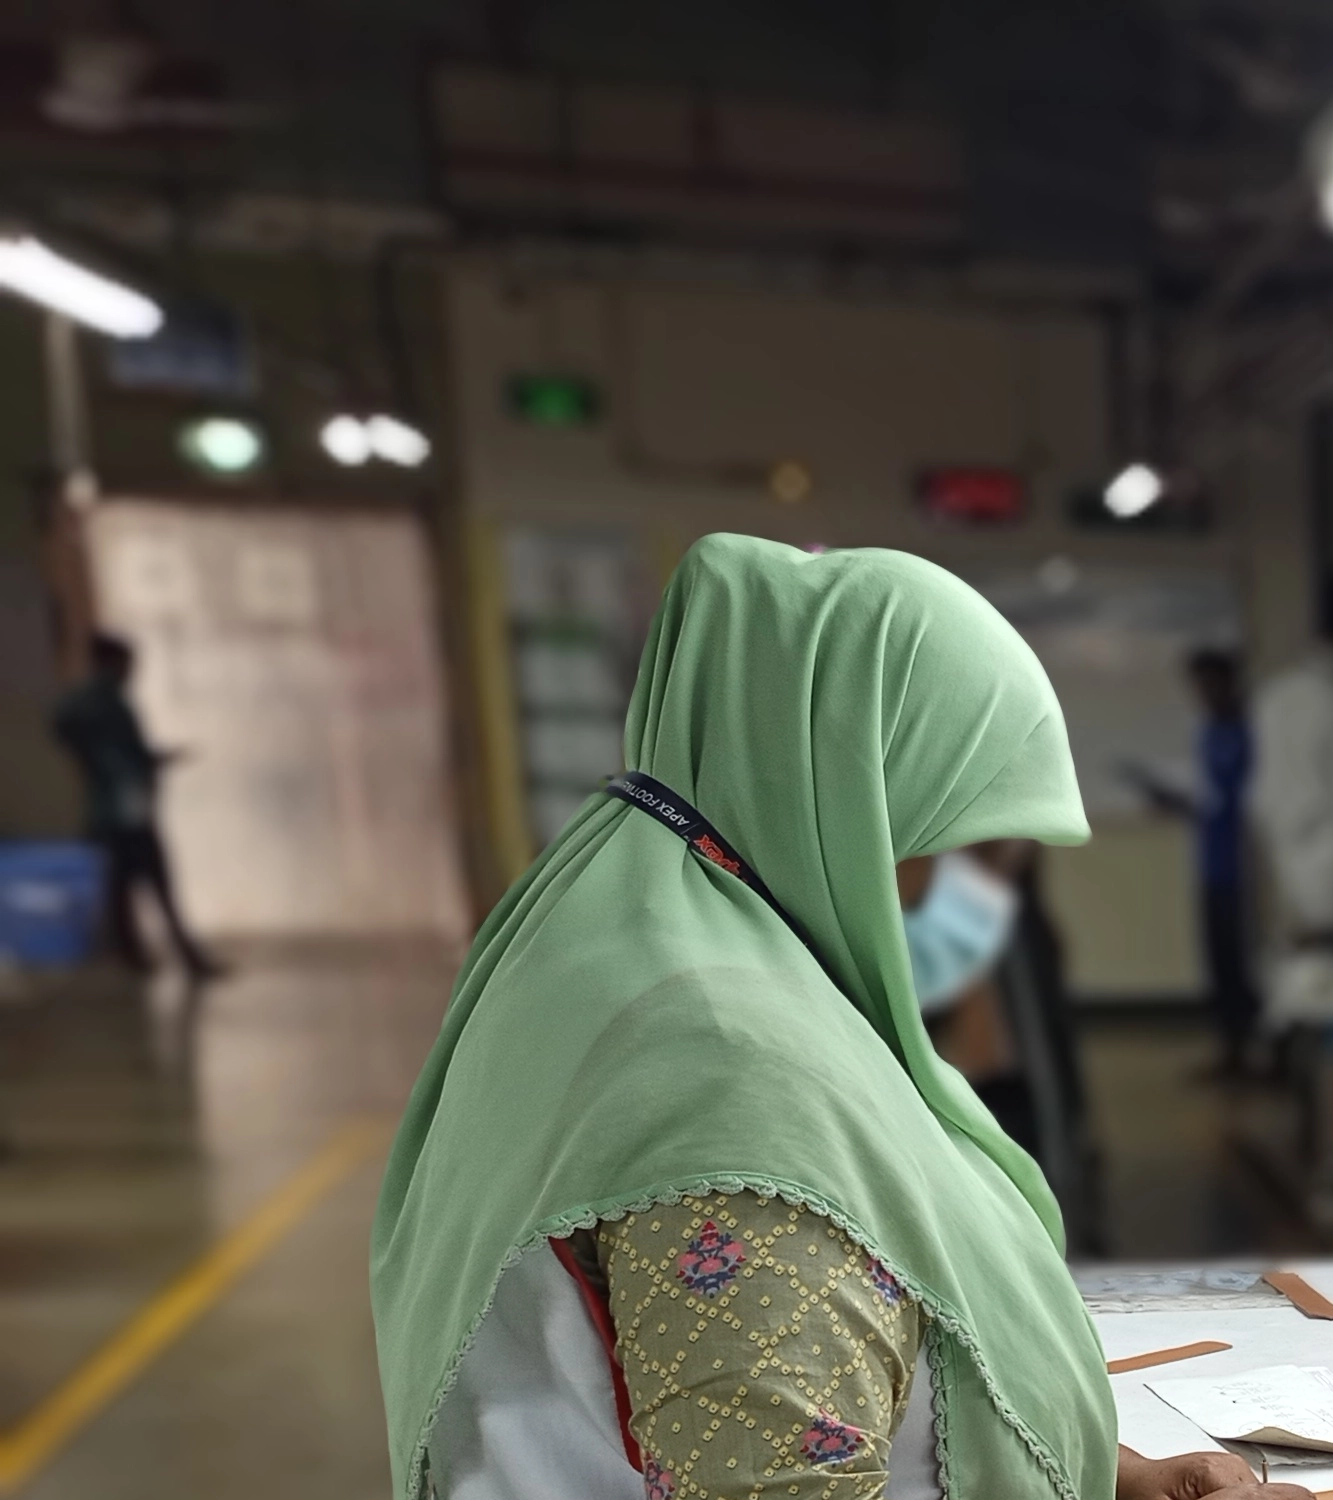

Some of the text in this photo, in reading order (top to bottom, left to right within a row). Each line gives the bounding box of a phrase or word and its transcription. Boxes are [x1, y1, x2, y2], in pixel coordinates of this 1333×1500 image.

[622, 780, 690, 826] APEX FOOTWE
[693, 834, 742, 876] pex
